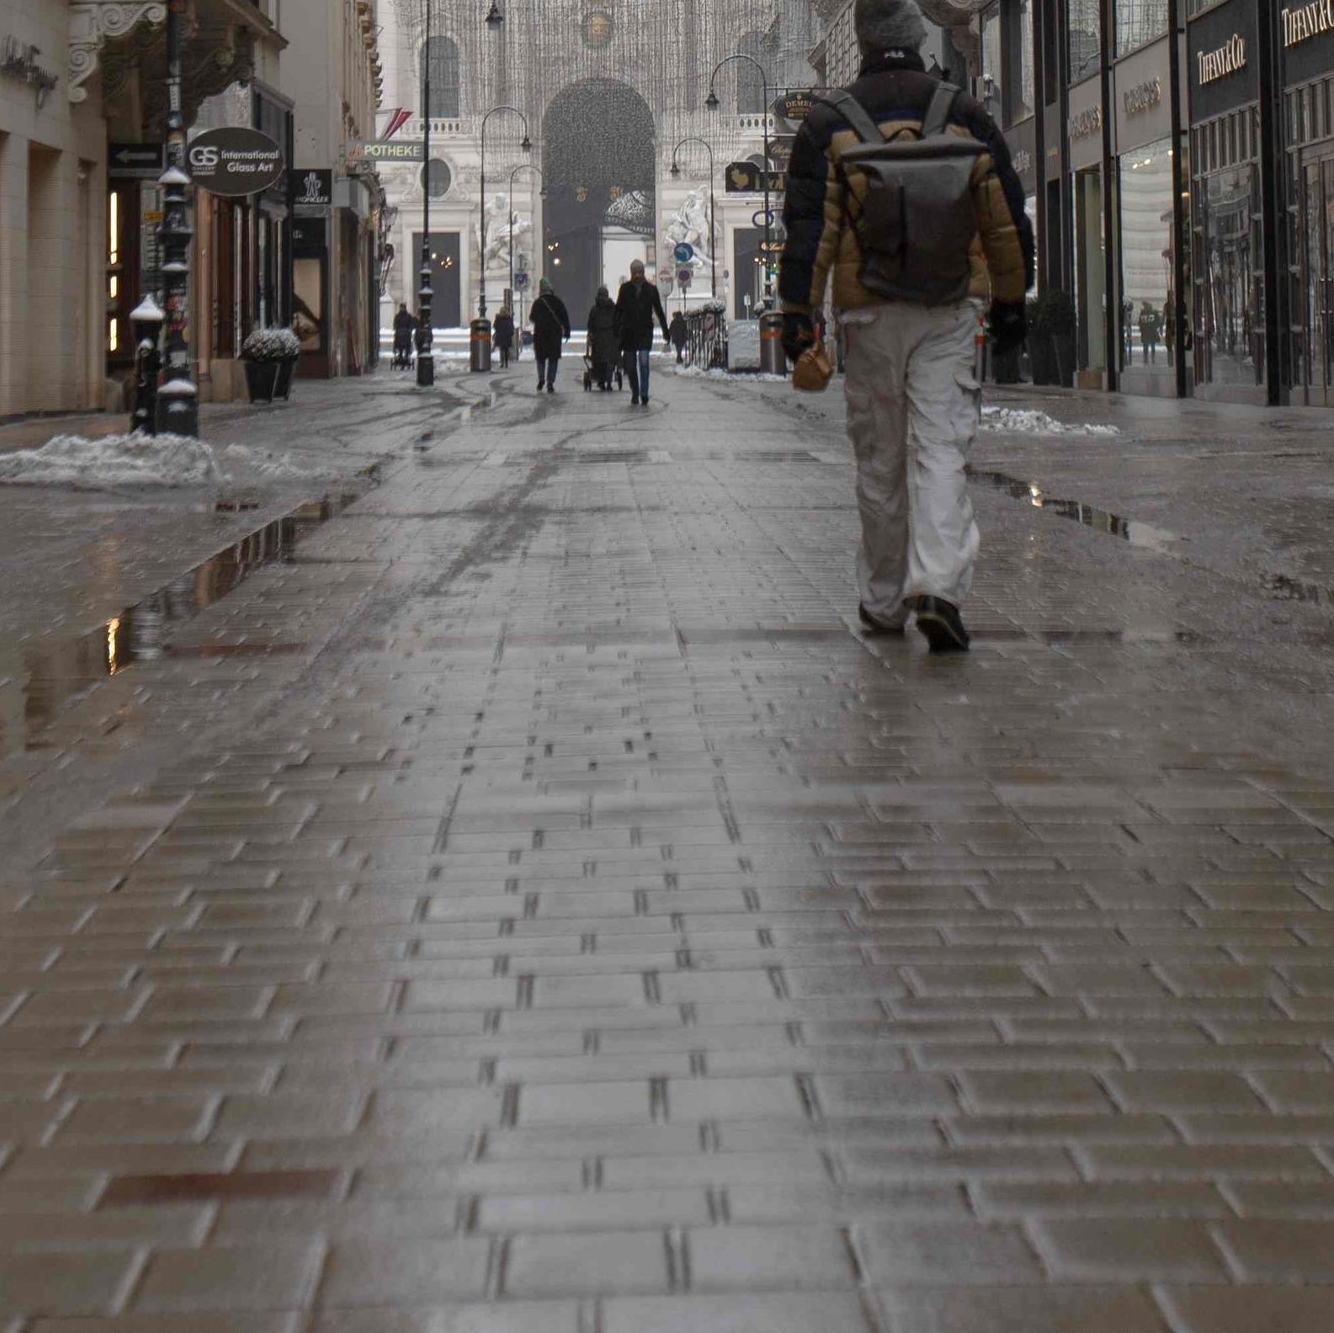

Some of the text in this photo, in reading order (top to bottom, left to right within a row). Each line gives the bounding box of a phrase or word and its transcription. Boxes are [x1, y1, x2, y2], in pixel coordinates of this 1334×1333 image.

[189, 146, 219, 166] GS
[221, 150, 279, 160] International
[348, 144, 421, 157] APOTHEKE
[227, 162, 274, 172] Glass Art
